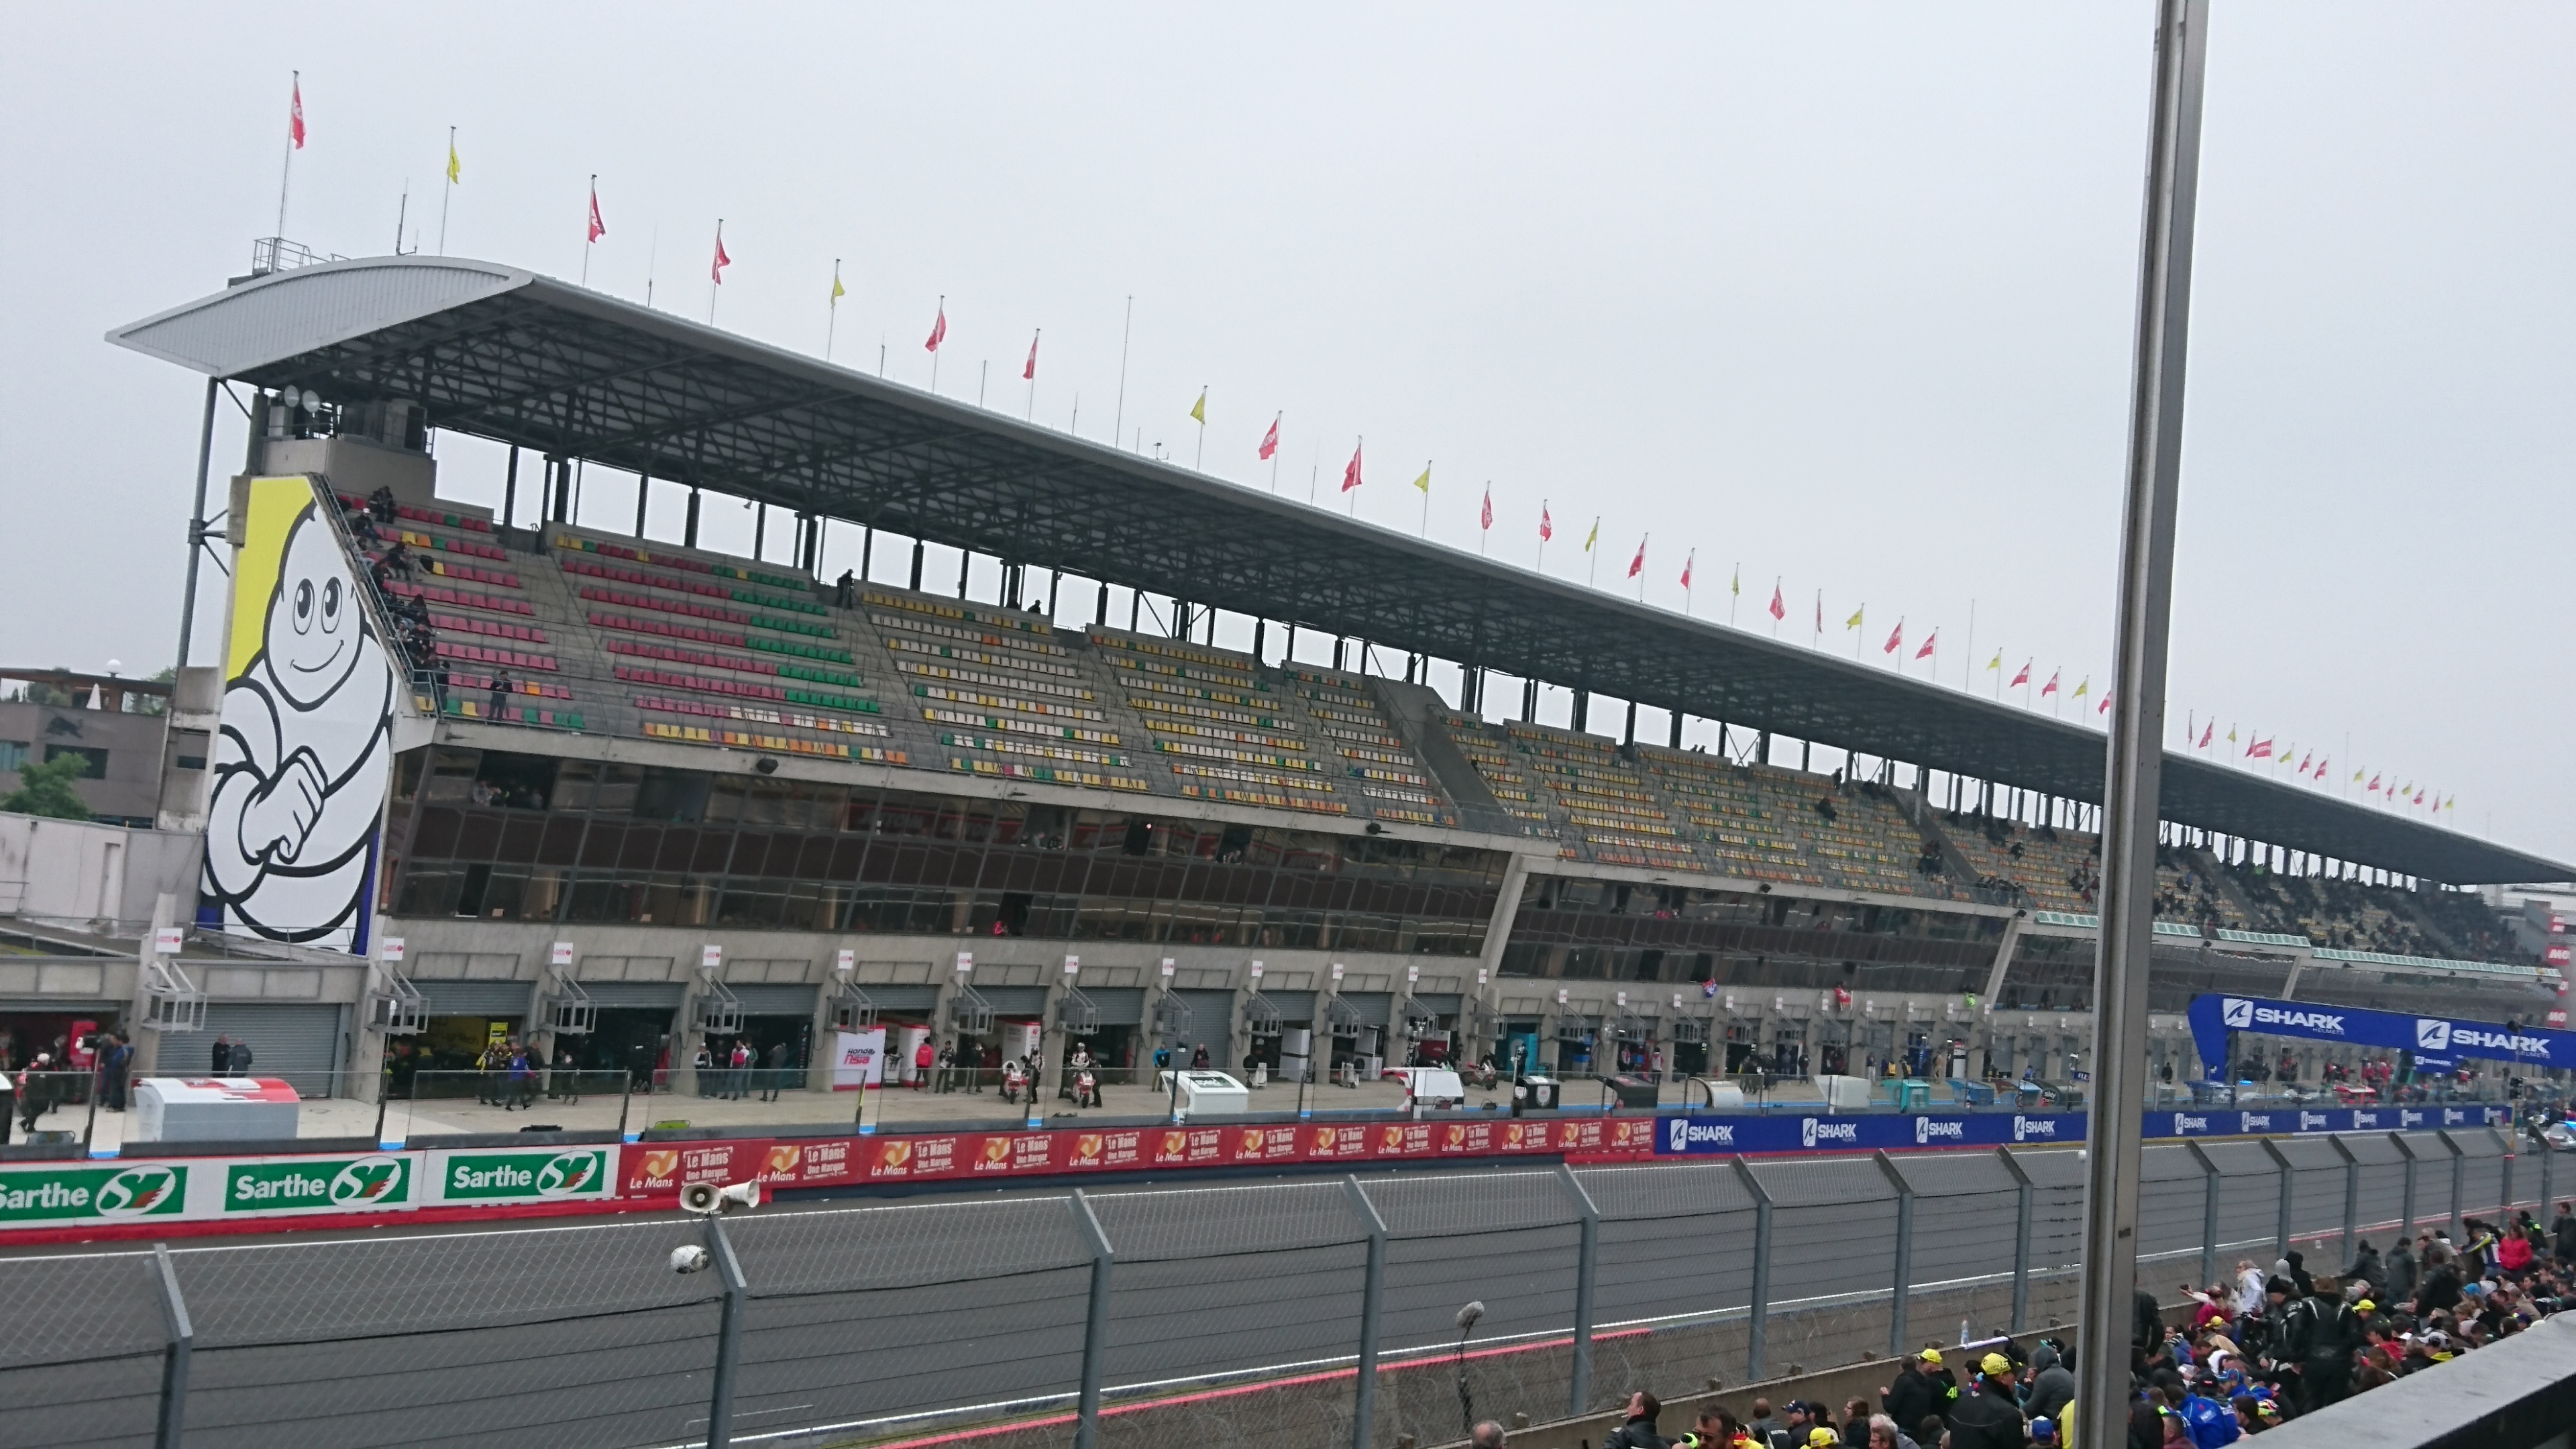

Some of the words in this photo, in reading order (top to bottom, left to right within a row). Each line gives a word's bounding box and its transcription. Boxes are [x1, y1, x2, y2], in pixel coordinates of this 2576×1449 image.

[2255, 1008, 2345, 1030] SHARK
[2453, 1030, 2551, 1054] SHARK
[2425, 1059, 2452, 1067] SHARK
[2044, 1091, 2056, 1099] sky
[2026, 1121, 2055, 1133] SHARK
[2184, 1117, 2207, 1128] SHARK
[2250, 1116, 2270, 1126] SHARK
[1688, 1126, 1733, 1141] SHARK
[1817, 1124, 1857, 1138] SHARK
[1929, 1122, 1963, 1135] SHARK
[1017, 1142, 1025, 1152] Le
[1028, 1140, 1048, 1151] Mans
[1108, 1139, 1116, 1149] Le
[1118, 1136, 1136, 1148] Mans
[808, 1150, 818, 1163] Le
[821, 1147, 845, 1161] Mans
[918, 1146, 927, 1157] Le
[930, 1143, 952, 1157] Mans
[1236, 1150, 1243, 1159] Le
[1244, 1150, 1260, 1158] Mans
[1318, 1147, 1333, 1155] Mans
[1379, 1146, 1385, 1154] Le
[687, 1155, 698, 1169] Le
[702, 1152, 729, 1167] Mans
[1069, 1157, 1078, 1166] Le
[1080, 1156, 1099, 1165] Mans
[1155, 1153, 1163, 1162] Le
[1165, 1152, 1183, 1161] Mans
[808, 1165, 820, 1174] Une
[821, 1163, 845, 1175] Marque
[871, 1166, 881, 1175] Le
[884, 1165, 907, 1175] Mans
[974, 1161, 983, 1170] Le
[986, 1161, 1006, 1170] Mans
[453, 1165, 532, 1189] Sarthe
[686, 1171, 699, 1181] Une
[702, 1167, 729, 1181] Marque
[757, 1172, 767, 1182] Le
[770, 1171, 796, 1181] Mans
[235, 1174, 325, 1200] Sarthe
[629, 1178, 643, 1189] Le
[645, 1177, 674, 1187] Mans
